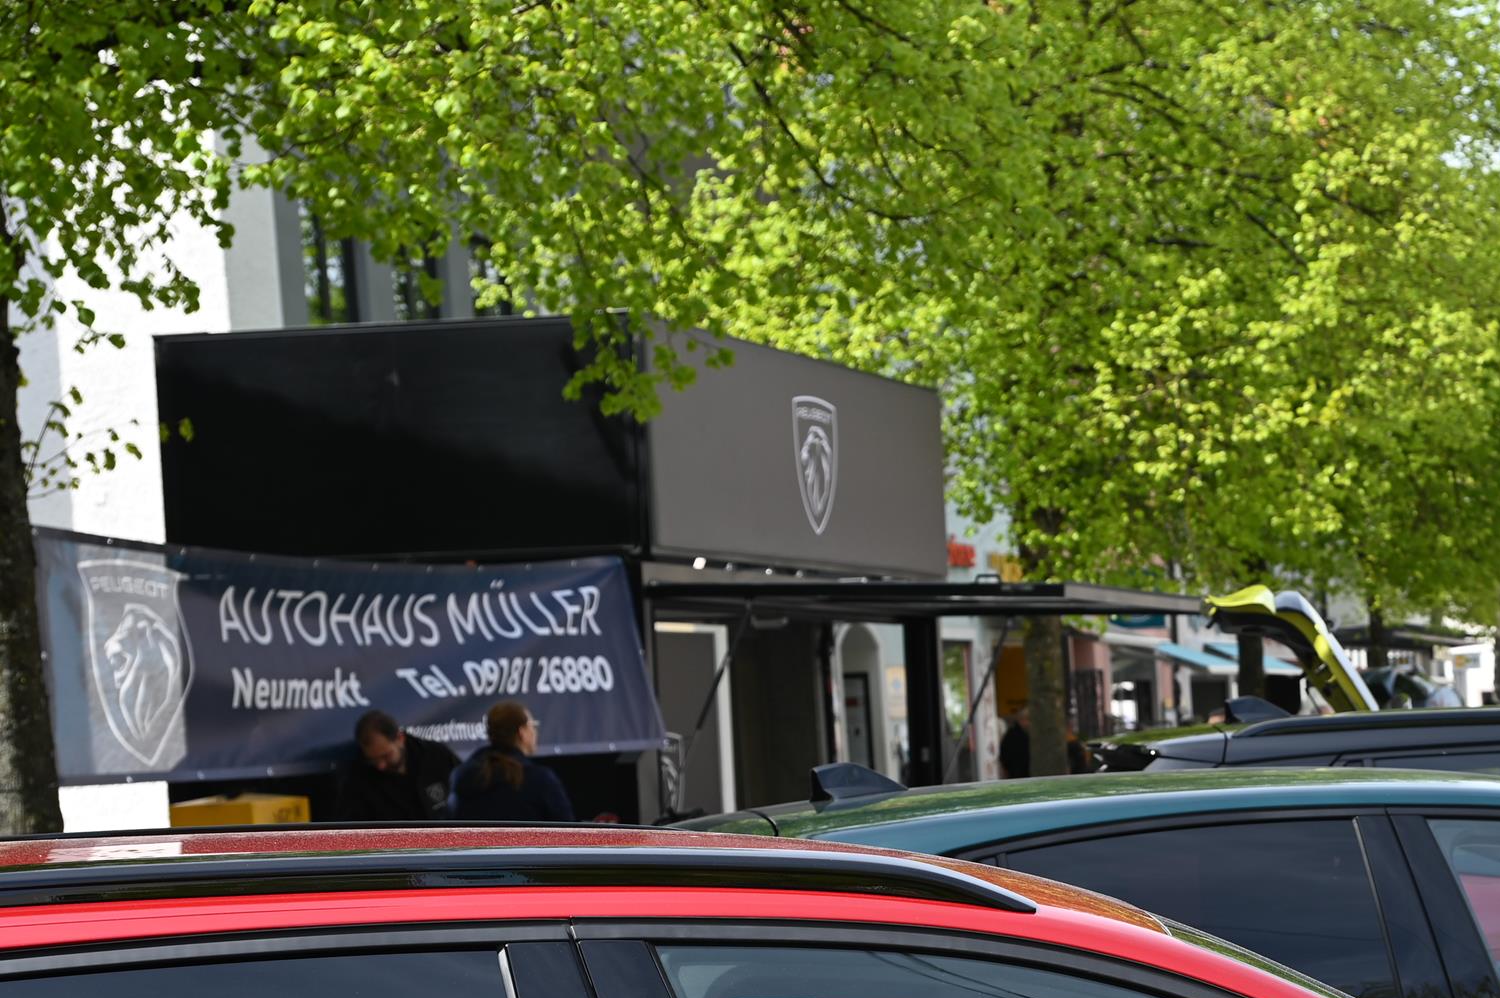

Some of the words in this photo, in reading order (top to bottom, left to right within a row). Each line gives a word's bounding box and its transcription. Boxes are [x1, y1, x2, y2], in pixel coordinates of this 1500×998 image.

[90, 575, 170, 598] PEUGEOT
[218, 585, 440, 648] AUTOHAUS
[446, 579, 602, 646] MÜLLER
[231, 666, 371, 710] Neumarkt
[396, 664, 466, 699] Tel.
[463, 656, 533, 696] 09181
[536, 654, 615, 694] 26880
